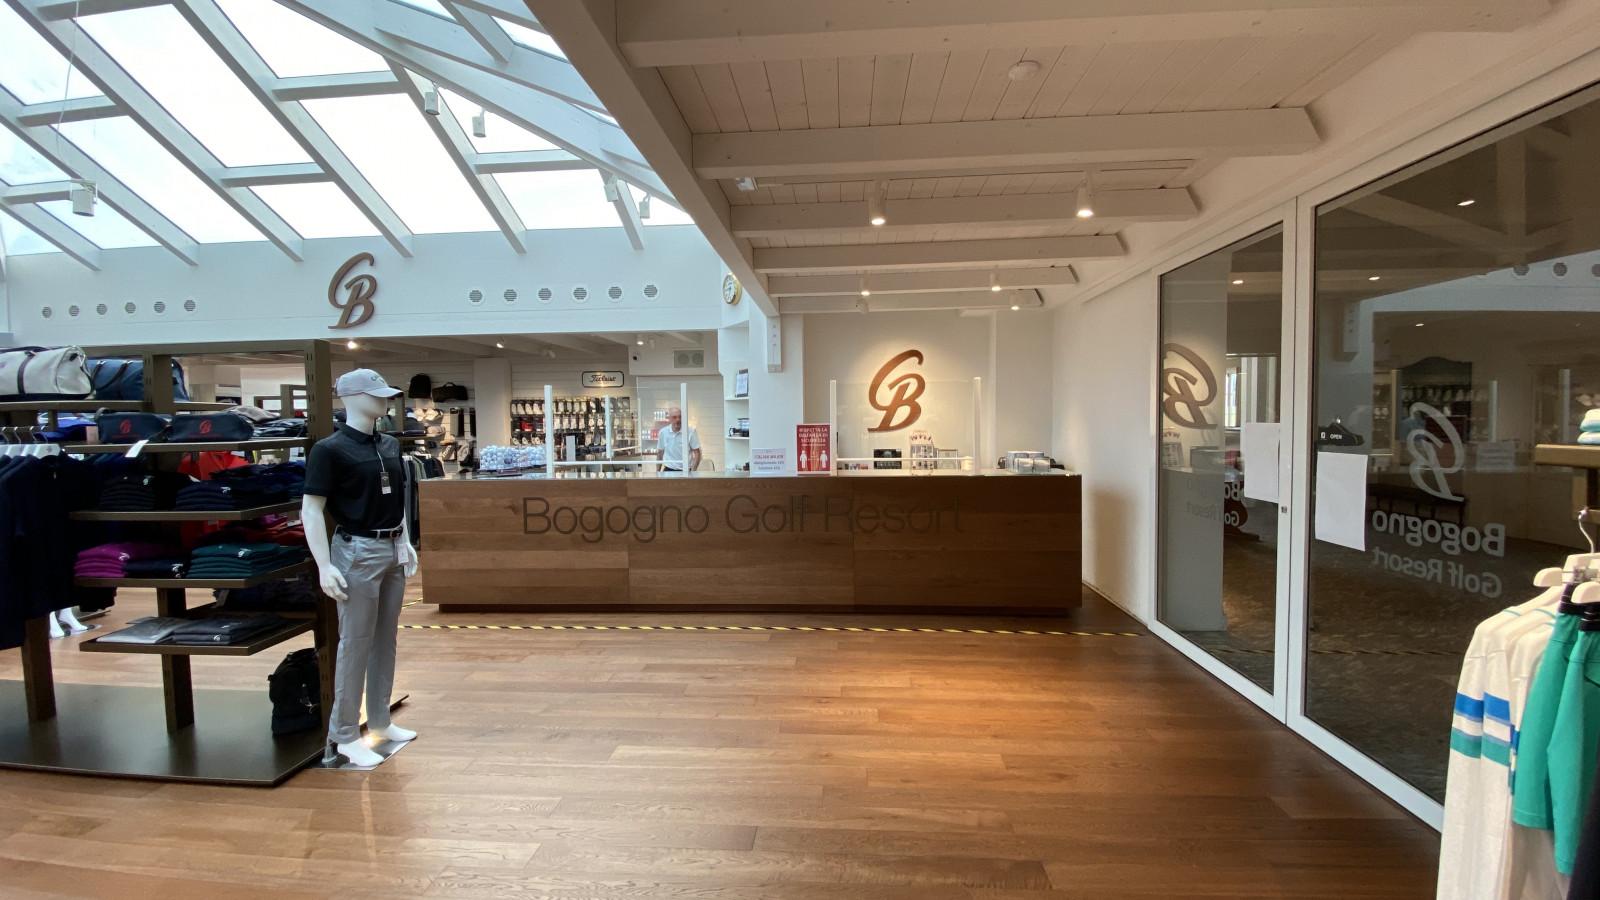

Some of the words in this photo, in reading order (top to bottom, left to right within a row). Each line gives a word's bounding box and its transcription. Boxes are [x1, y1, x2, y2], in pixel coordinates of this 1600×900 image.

[522, 497, 710, 543] Bogogno
[725, 494, 809, 533] Golf
[823, 494, 964, 534] Resort
